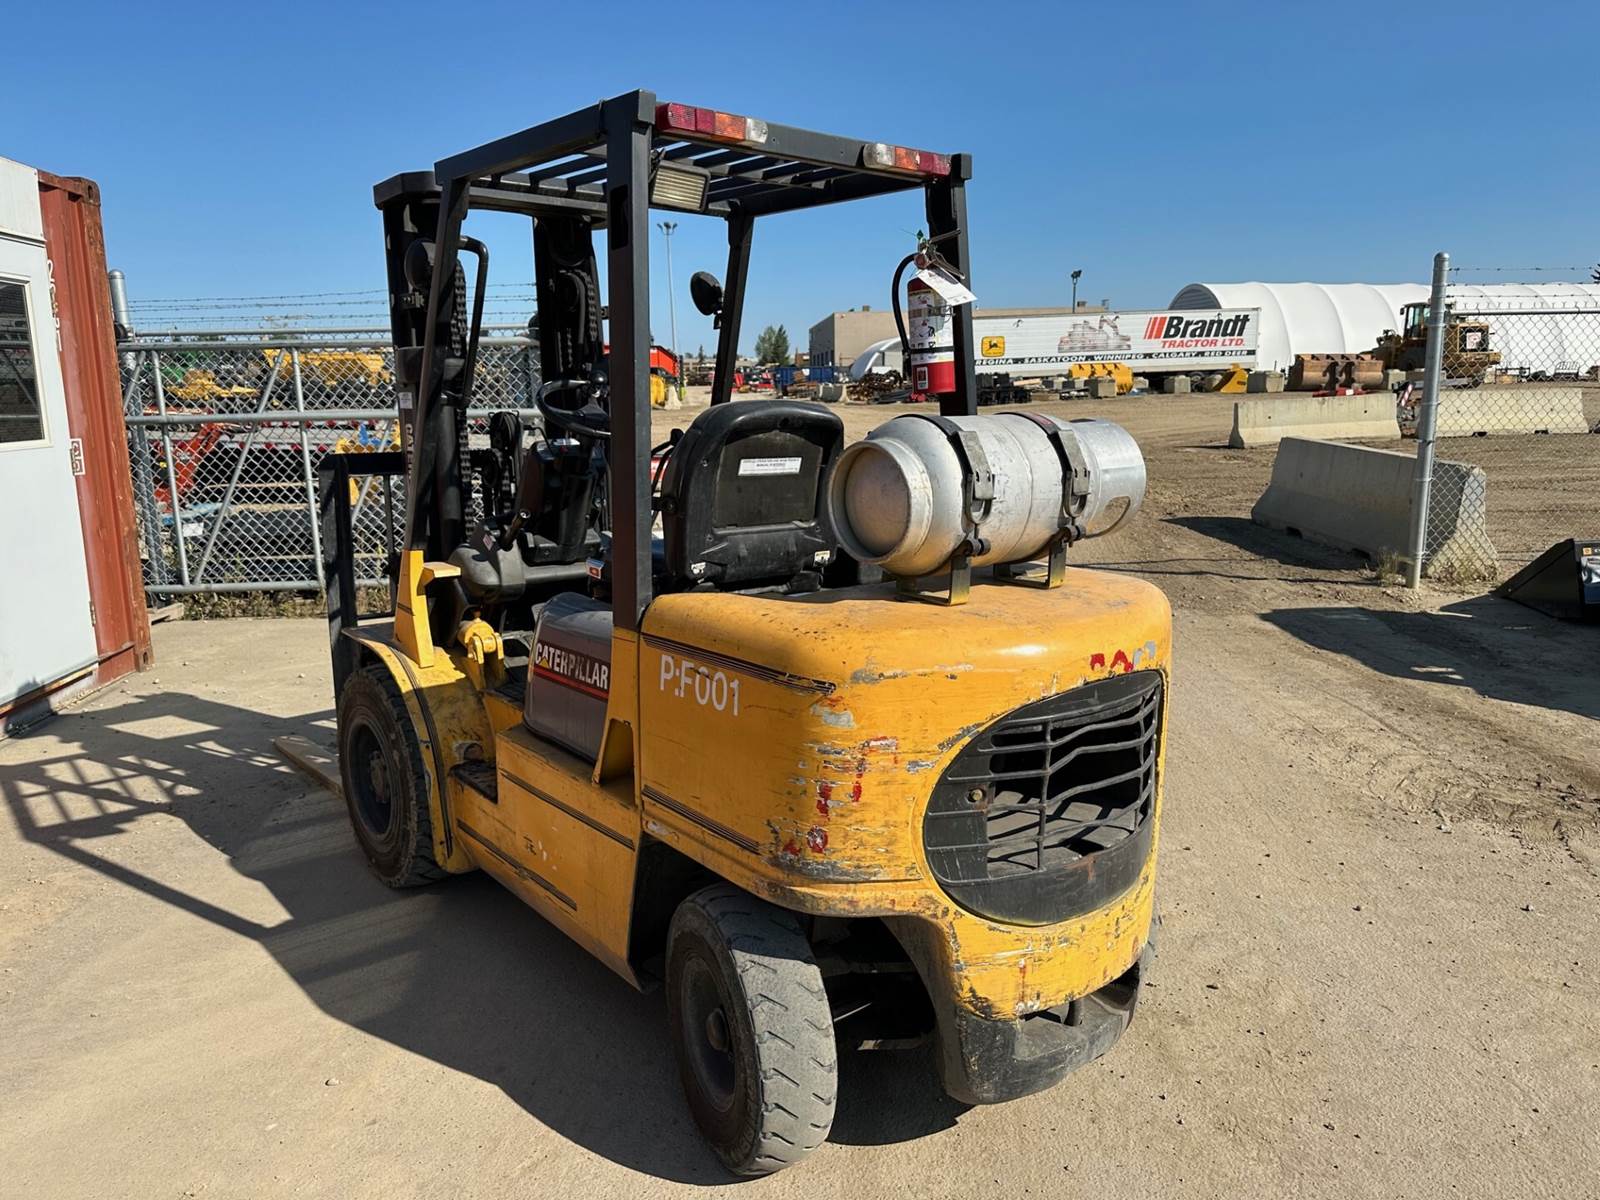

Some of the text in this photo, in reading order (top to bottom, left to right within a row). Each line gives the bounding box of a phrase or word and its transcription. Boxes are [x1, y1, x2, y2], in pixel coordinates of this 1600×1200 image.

[1163, 314, 1250, 339] Brandt
[1161, 337, 1246, 349] TRACTOR LTD.
[975, 358, 1014, 366] REGINA
[1023, 354, 1087, 364] SASKATOON
[1093, 352, 1145, 361] WINNIPEG
[1151, 351, 1197, 359] CALGARY
[535, 642, 609, 690] CATERPILLAR
